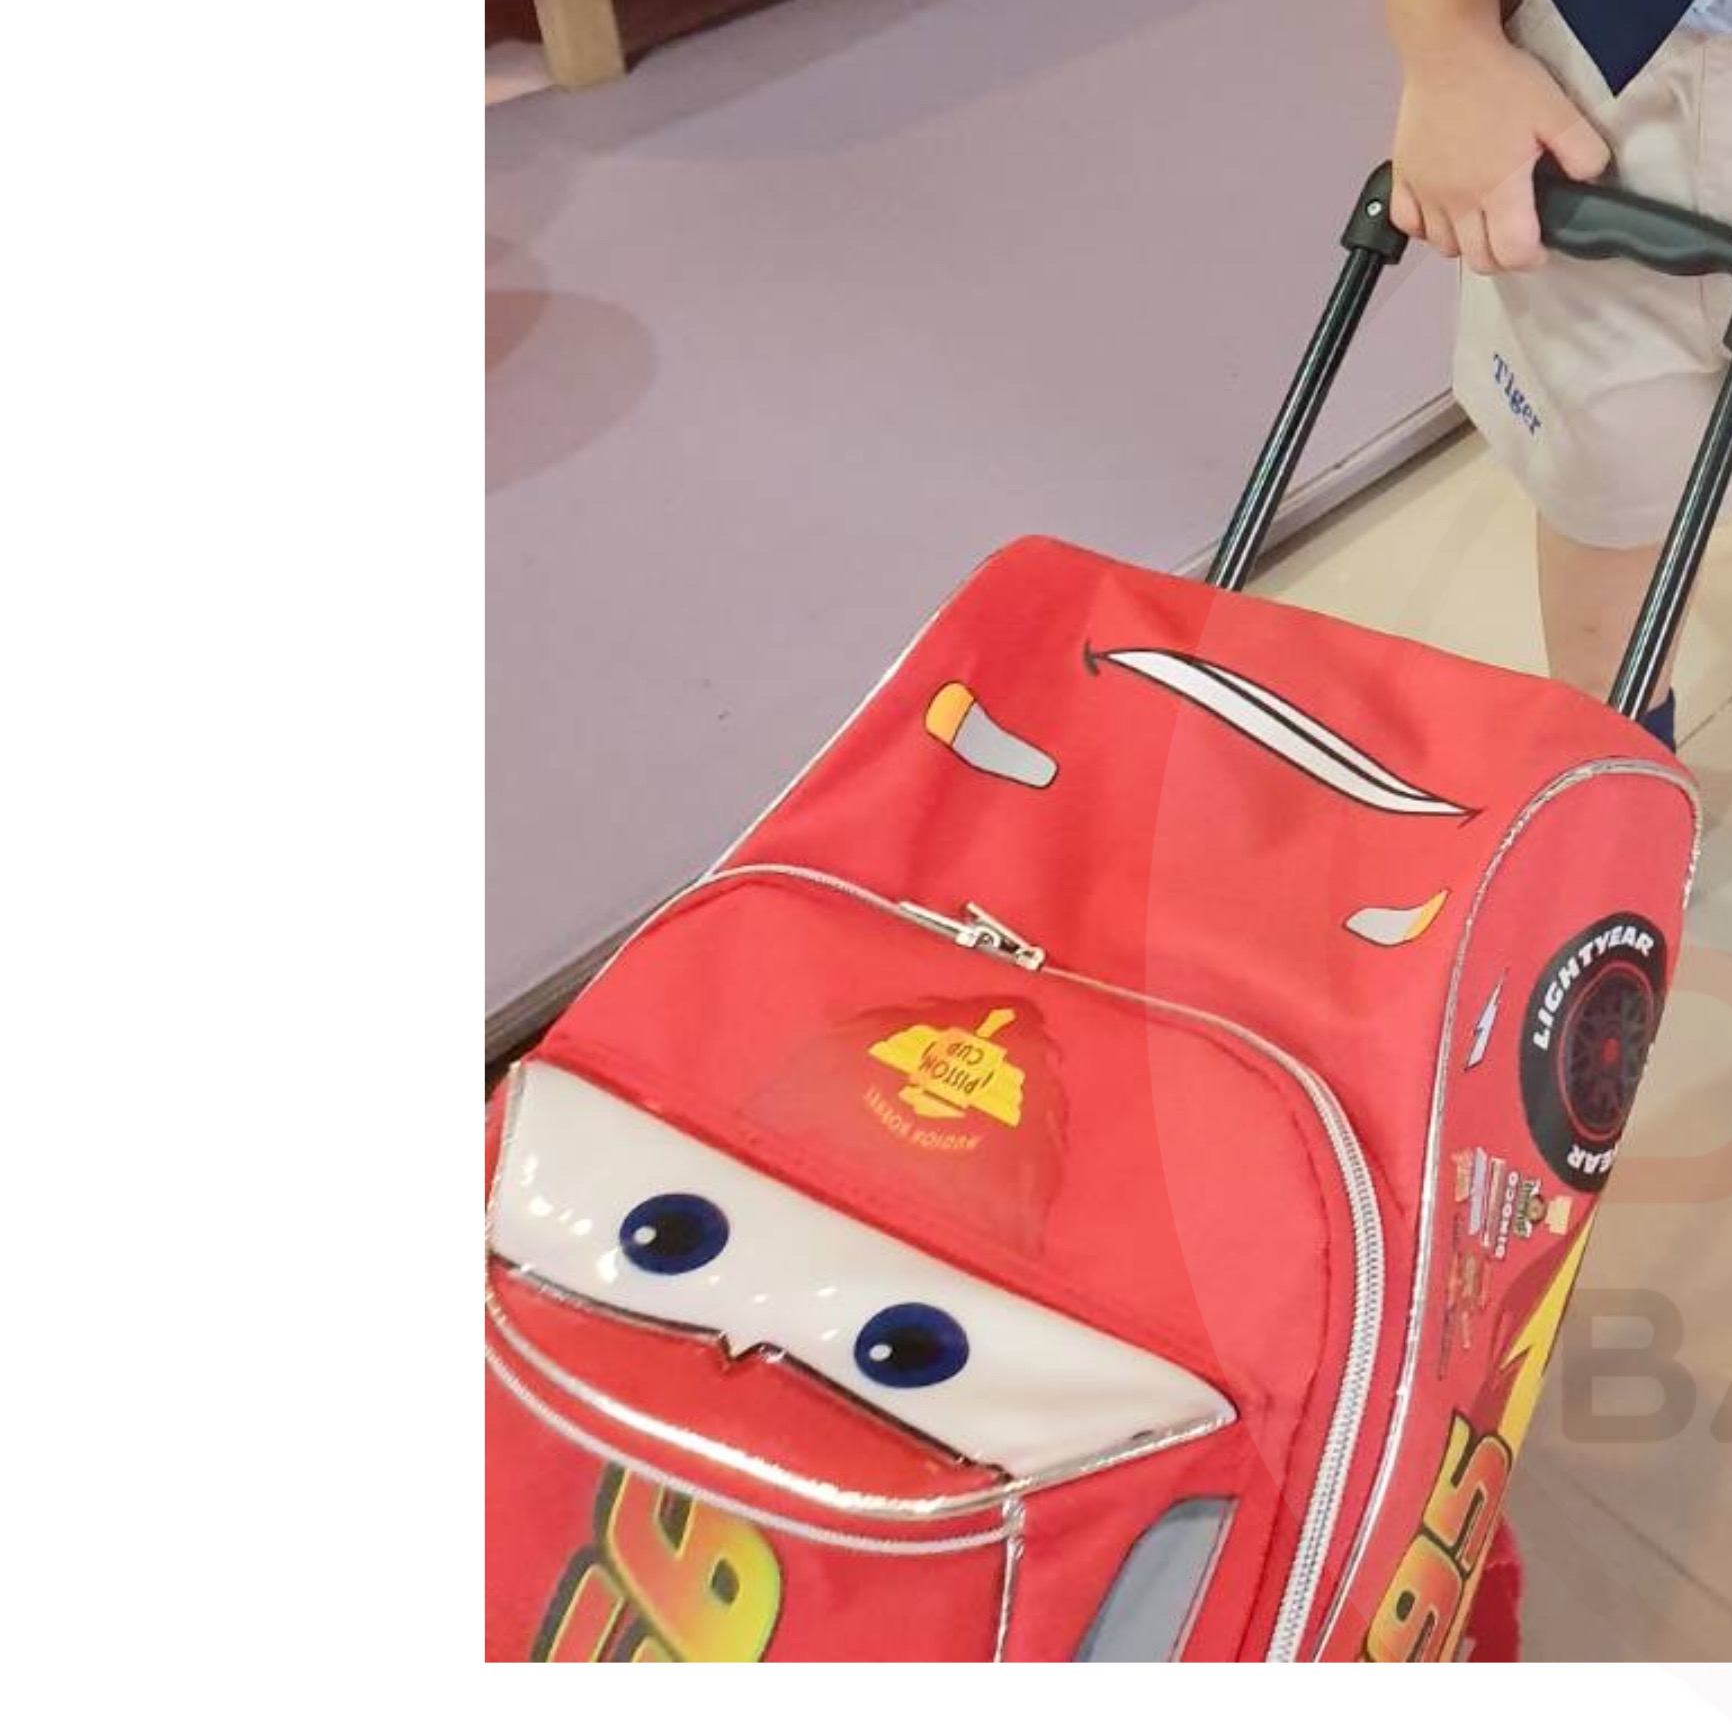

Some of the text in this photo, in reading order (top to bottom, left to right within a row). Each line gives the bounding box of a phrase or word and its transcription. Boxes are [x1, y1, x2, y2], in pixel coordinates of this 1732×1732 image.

[1493, 351, 1541, 436] Tiger
[1532, 925, 1655, 1051] LIGHTYEAR
[946, 1040, 985, 1067] CUP
